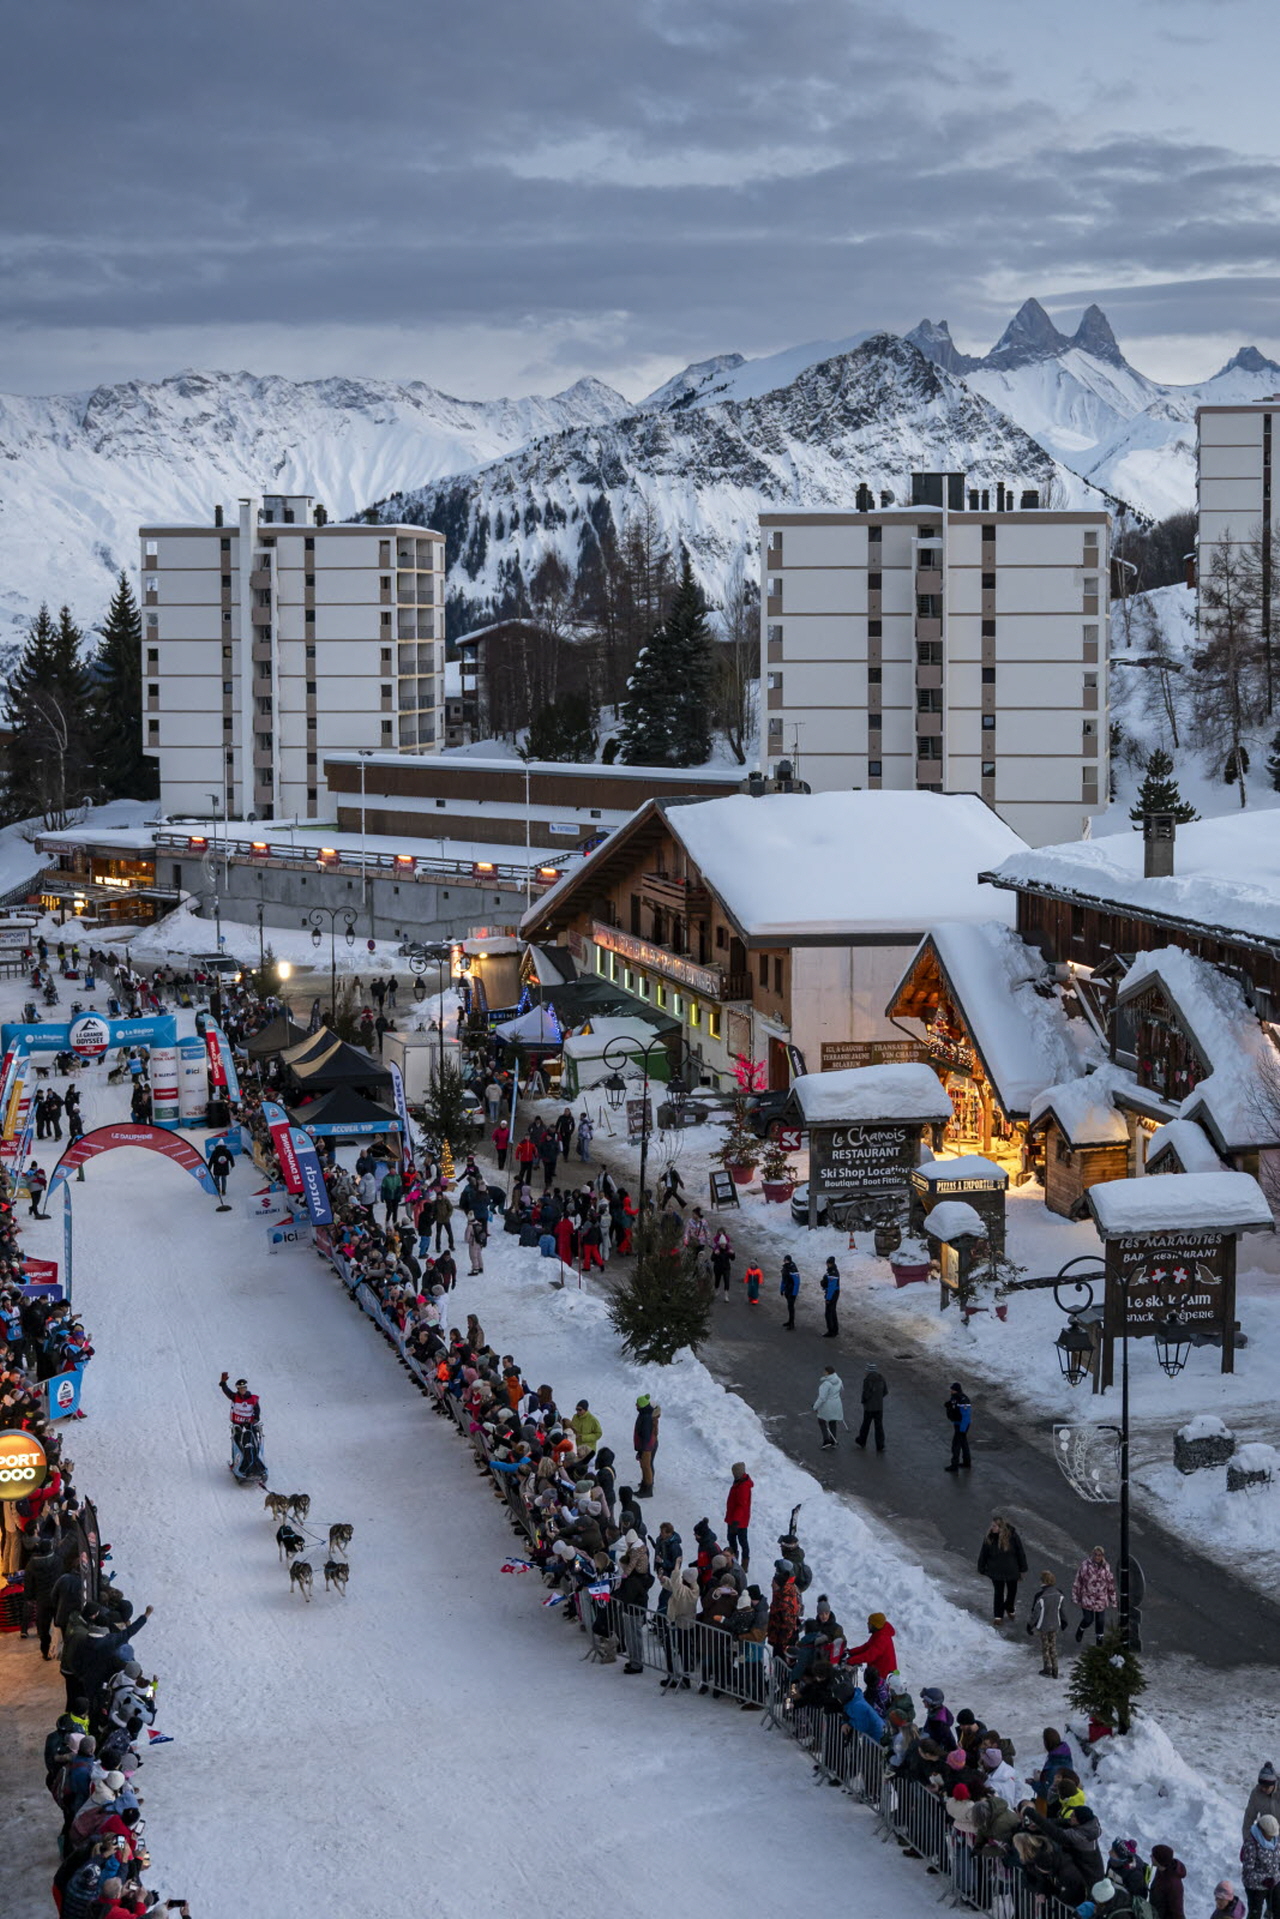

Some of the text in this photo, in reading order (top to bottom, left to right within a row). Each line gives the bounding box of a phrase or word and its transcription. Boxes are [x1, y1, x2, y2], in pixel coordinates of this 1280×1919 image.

[331, 1124, 374, 1133] ACCUEIL VIP
[832, 1126, 907, 1148] Le Chamois
[832, 1147, 901, 1160] RESTAURANT
[820, 1168, 836, 1179] Ski
[838, 1167, 866, 1179] Shop
[824, 1179, 860, 1188] Boutique
[862, 1178, 881, 1186] Boot
[255, 1208, 280, 1216] SUZUKI
[283, 1229, 298, 1243] ici
[1123, 1253, 1144, 1263] BAR
